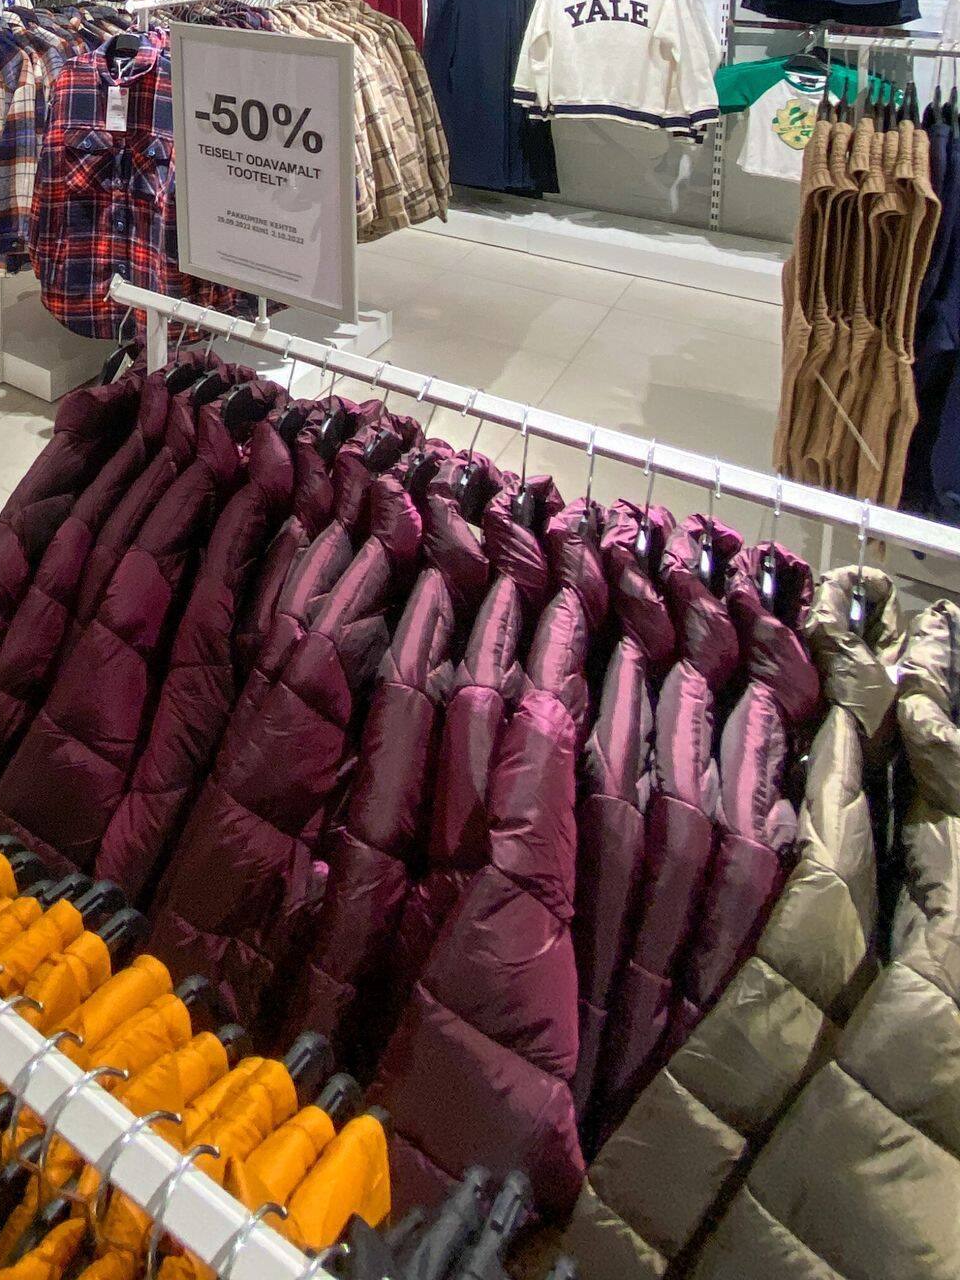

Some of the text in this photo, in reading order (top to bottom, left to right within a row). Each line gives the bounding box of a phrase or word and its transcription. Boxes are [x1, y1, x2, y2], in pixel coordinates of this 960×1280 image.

[195, 93, 323, 154] -50%
[198, 143, 322, 180] TEISELT ODAVAMALT
